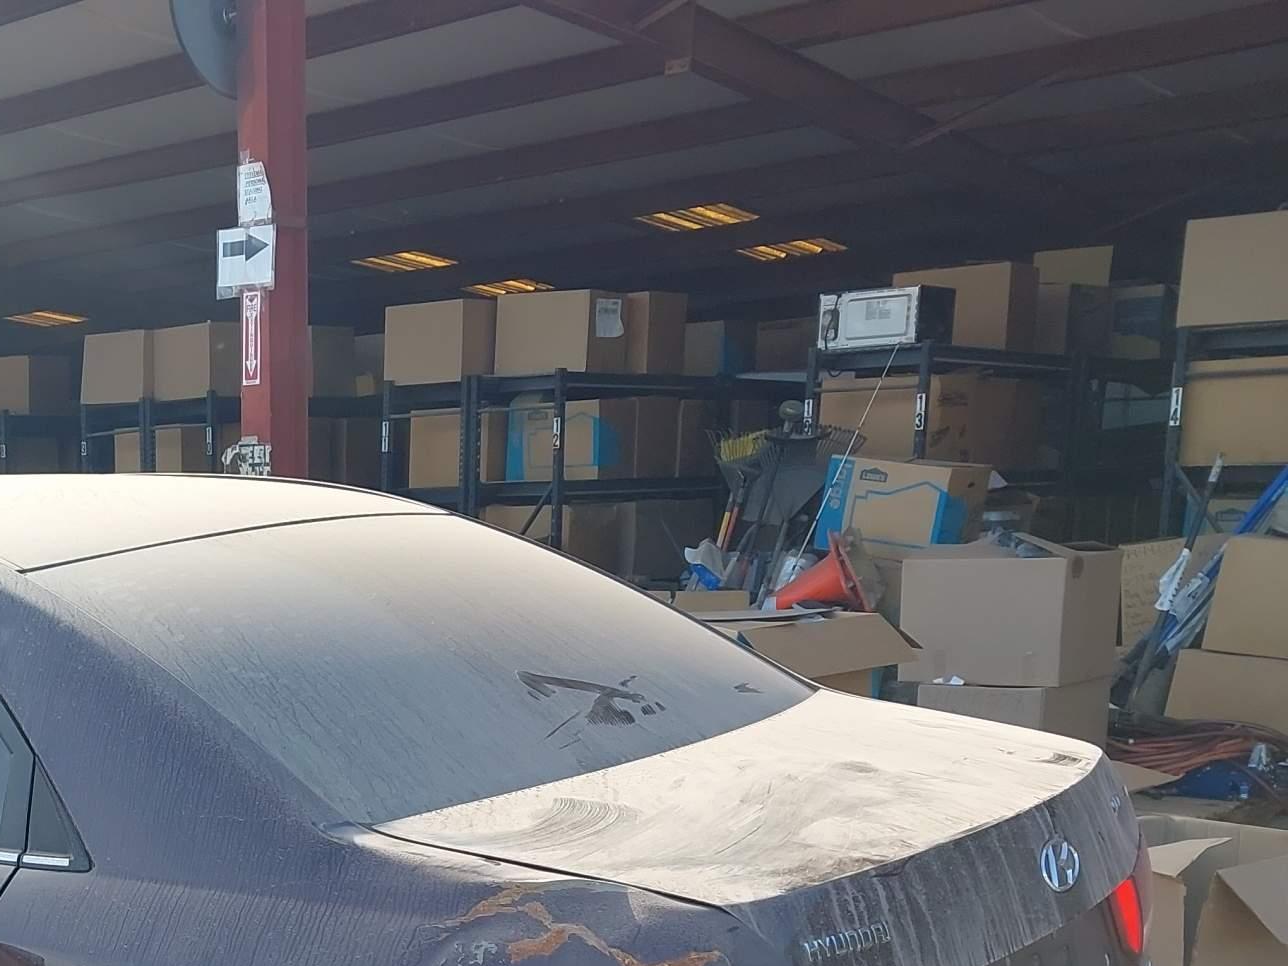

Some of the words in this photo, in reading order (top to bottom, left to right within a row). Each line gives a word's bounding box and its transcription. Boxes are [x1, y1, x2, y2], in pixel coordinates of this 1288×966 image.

[916, 394, 925, 429] 13
[1171, 388, 1181, 425] 14
[552, 418, 560, 448] 12
[804, 921, 891, 962] HYUNDAI
